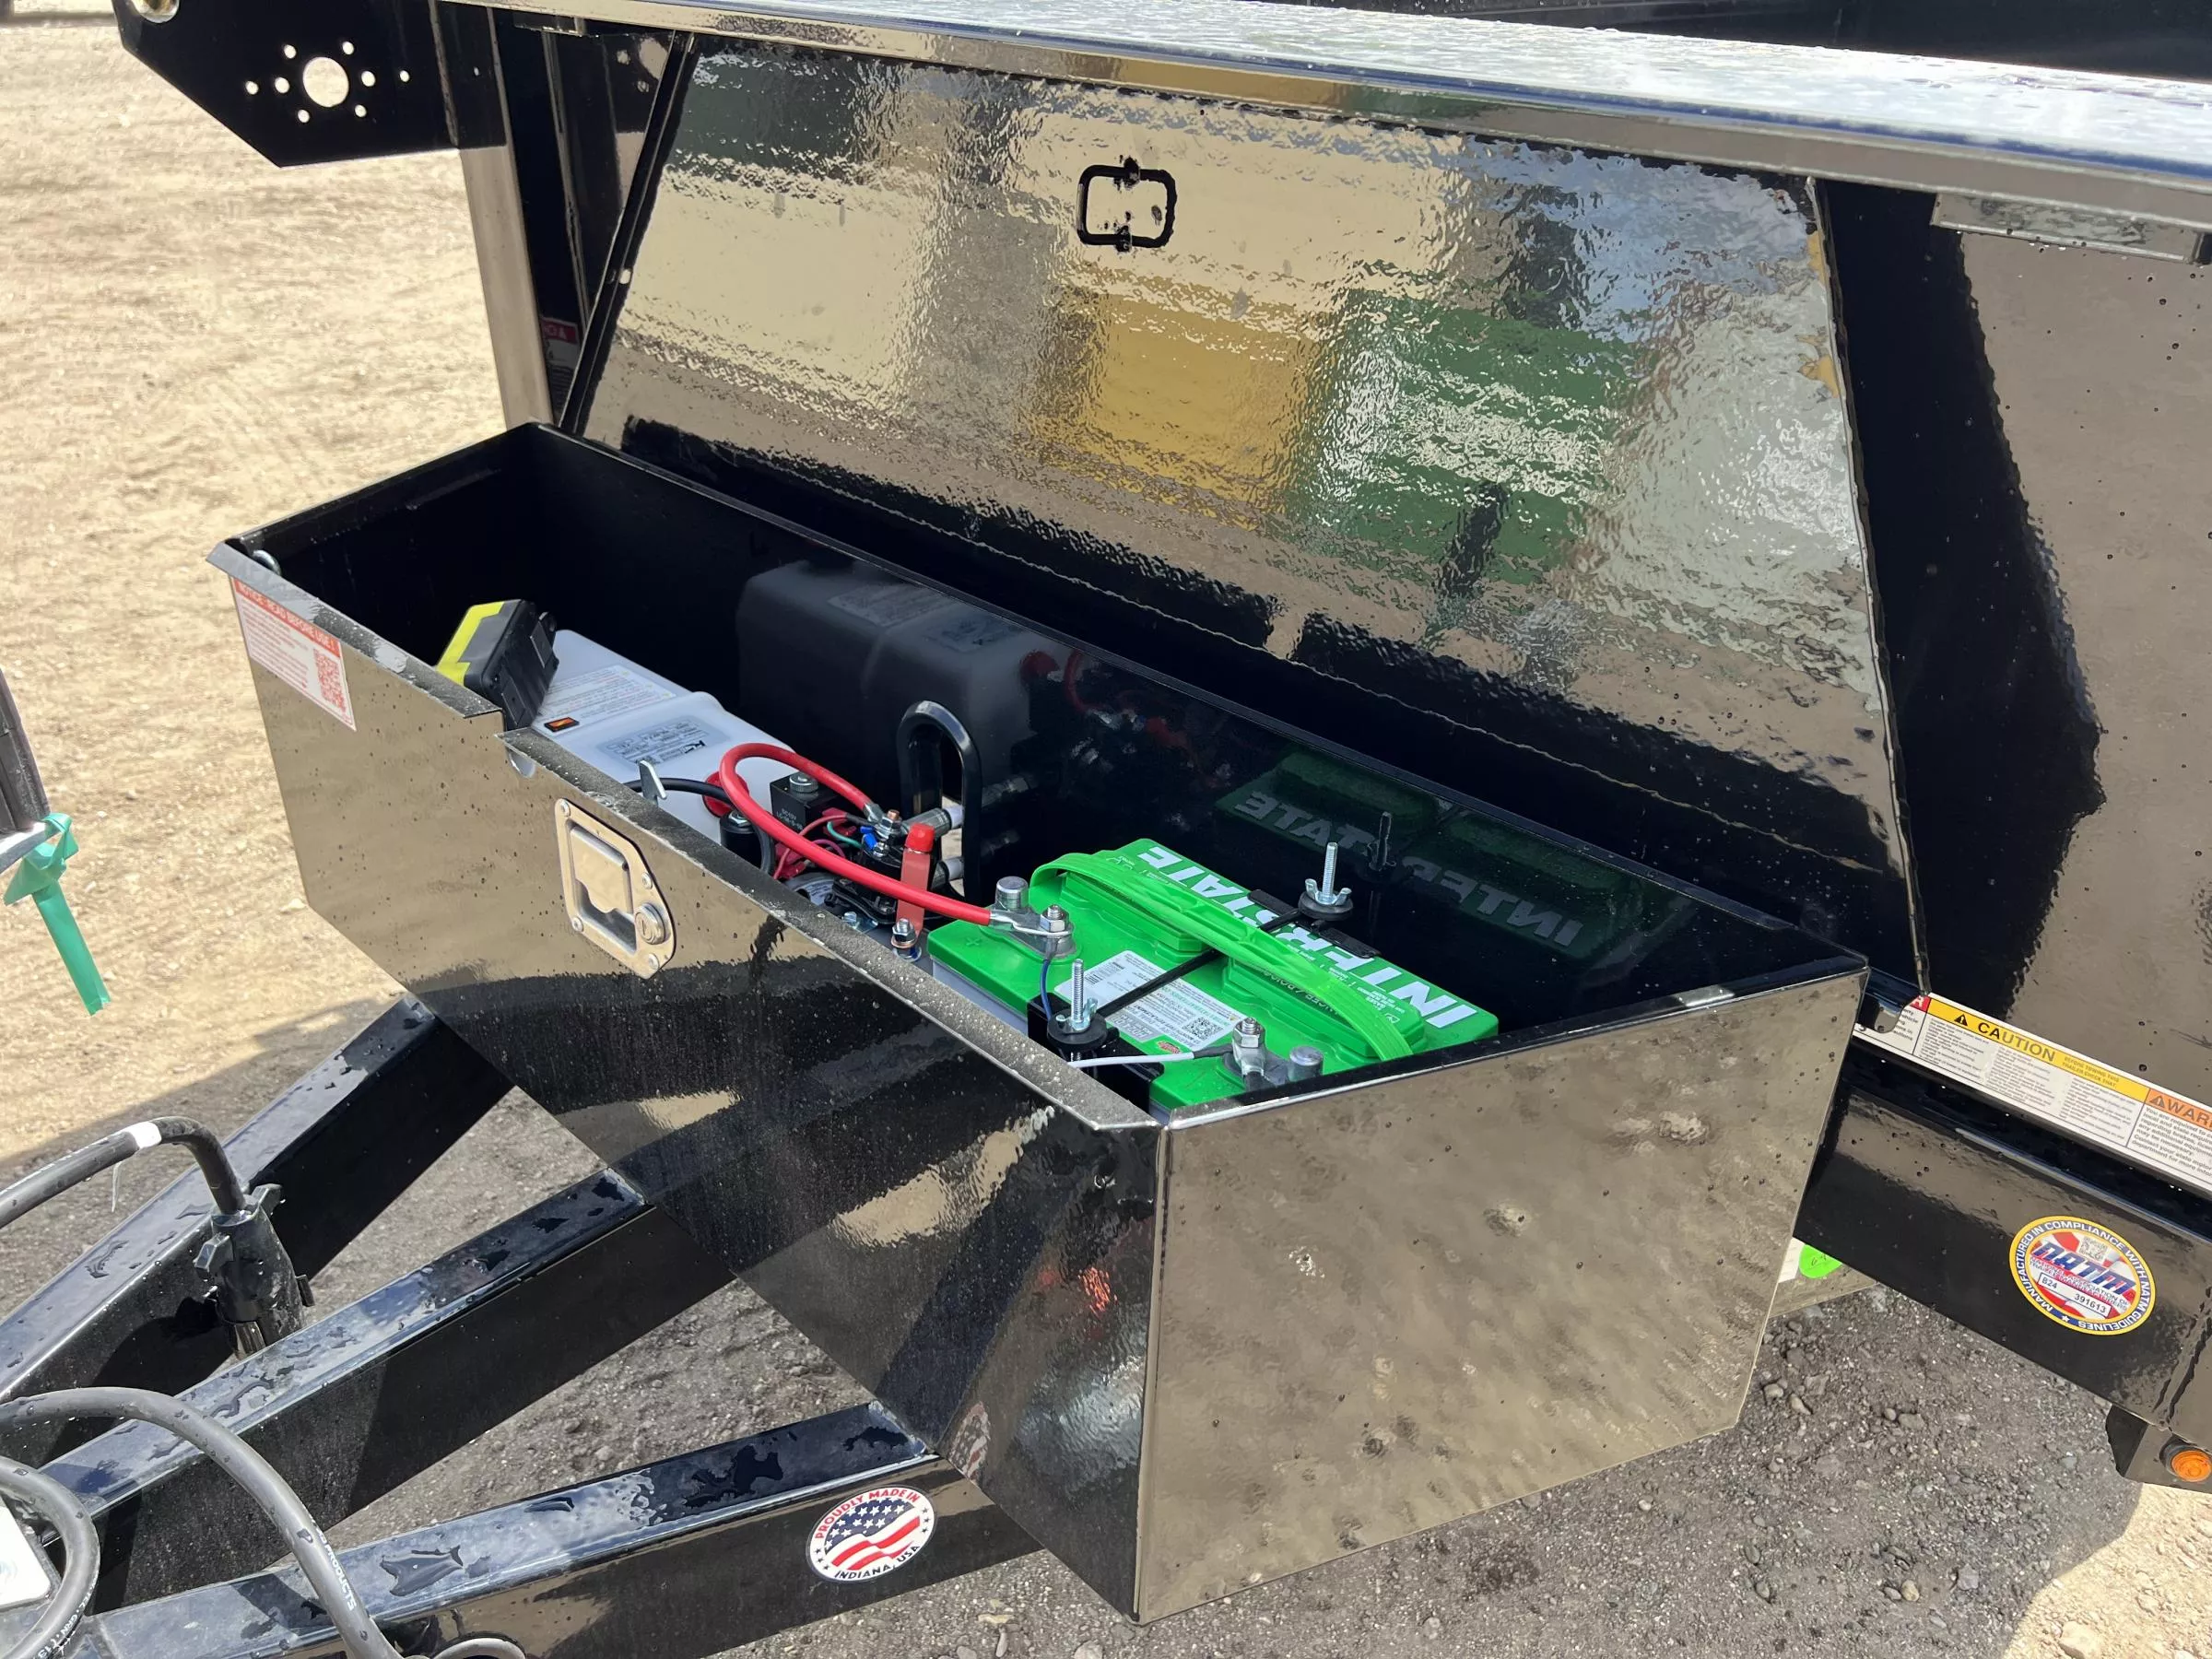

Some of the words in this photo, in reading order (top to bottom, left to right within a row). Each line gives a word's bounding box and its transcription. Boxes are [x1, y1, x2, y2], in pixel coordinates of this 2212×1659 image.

[1978, 1022, 2055, 1062] CAUTION
[2043, 1220, 2123, 1250] COMPLIANCE
[2016, 1233, 2053, 1312] MANUFACTURED
[2125, 1250, 2146, 1278] WITH
[2041, 1277, 2058, 1288] B24
[2073, 1292, 2106, 1313] 391613
[2136, 1279, 2151, 1315] NATM
[2077, 1311, 2142, 1332] GUIDELINES
[815, 1494, 864, 1539] PROUDLY
[869, 1488, 907, 1500] MADE
[905, 1490, 921, 1503] IN
[324, 1543, 357, 1611] PRODUCTS
[834, 1563, 896, 1579] INDIANA,
[897, 1545, 921, 1563] USA
